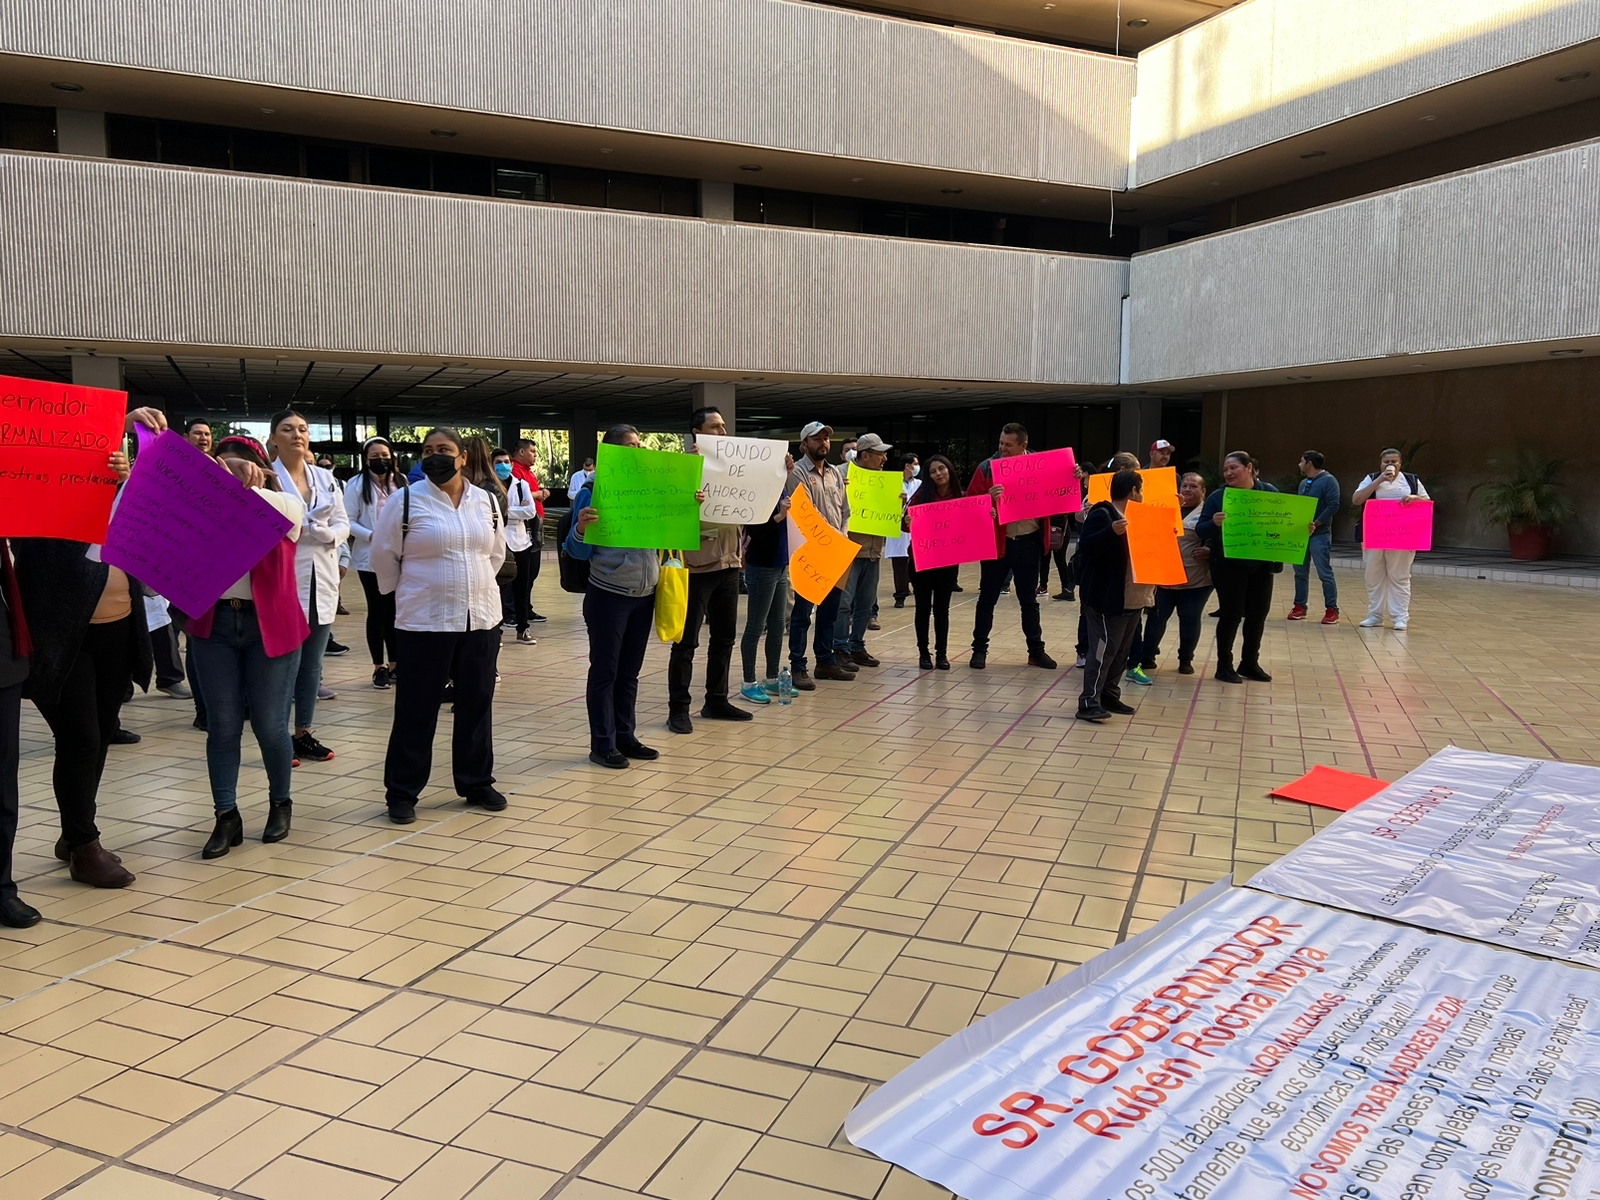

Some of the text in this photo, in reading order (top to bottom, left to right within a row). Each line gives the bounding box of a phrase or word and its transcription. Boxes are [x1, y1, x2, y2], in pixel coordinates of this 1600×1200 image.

[715, 439, 771, 461] FONDO
[728, 464, 746, 478] DE
[1000, 457, 1048, 478] BONO
[152, 458, 224, 515] NORMALIZADOS
[599, 483, 611, 500] No
[703, 483, 756, 502] AHORRO
[853, 489, 866, 500] DE
[1025, 491, 1038, 501] DE
[252, 507, 267, 519] de
[703, 504, 755, 522] (FEAC)
[798, 501, 833, 546] BONO
[934, 520, 951, 531] DE
[917, 536, 965, 554] SUELDO
[798, 555, 832, 591] REYES
[1492, 974, 1518, 994] que
[1480, 992, 1506, 1011] con
[972, 915, 1303, 1149] SR. GOBERNADOR
[1454, 1009, 1493, 1048] cumpla
[1073, 946, 1329, 1140] Rubén Rocha Moya
[1236, 1117, 1271, 1142] que
[1261, 1101, 1287, 1119] se
[1276, 1077, 1308, 1102] nos
[1297, 1030, 1349, 1079] otorguen
[1334, 1006, 1374, 1033] todas
[1358, 993, 1387, 1008] las
[1376, 946, 1431, 994] prestaciones
[1537, 1045, 1564, 1061] de
[1110, 1179, 1155, 1200] os
[1139, 1147, 1184, 1183] 500
[1170, 1076, 1261, 1153] trabajadores
[1333, 981, 1357, 991] le
[1348, 941, 1398, 982] solicitamos
[1427, 1045, 1469, 1074] favor
[1419, 1065, 1448, 1097] por
[1481, 1067, 1503, 1078] a
[1525, 1059, 1556, 1085] años
[1280, 1078, 1355, 1153] económicas
[1342, 1055, 1372, 1082] que
[1361, 1035, 1390, 1058] nos
[1470, 1076, 1497, 1092] no
[1513, 1083, 1543, 1101] 22
[1289, 1172, 1328, 1198] NO
[1311, 1120, 1370, 1174] SOMOS
[1351, 1029, 1440, 1123] TRABAJADORES
[1423, 1014, 1452, 1035] DE
[1463, 1091, 1491, 1109] y
[1382, 1092, 1435, 1137] bases
[1508, 1102, 1534, 1123] con
[1365, 1137, 1405, 1159] las
[1420, 1104, 1480, 1171] completas
[1480, 1124, 1522, 1159] hasta
[1351, 1159, 1389, 1183] dio
